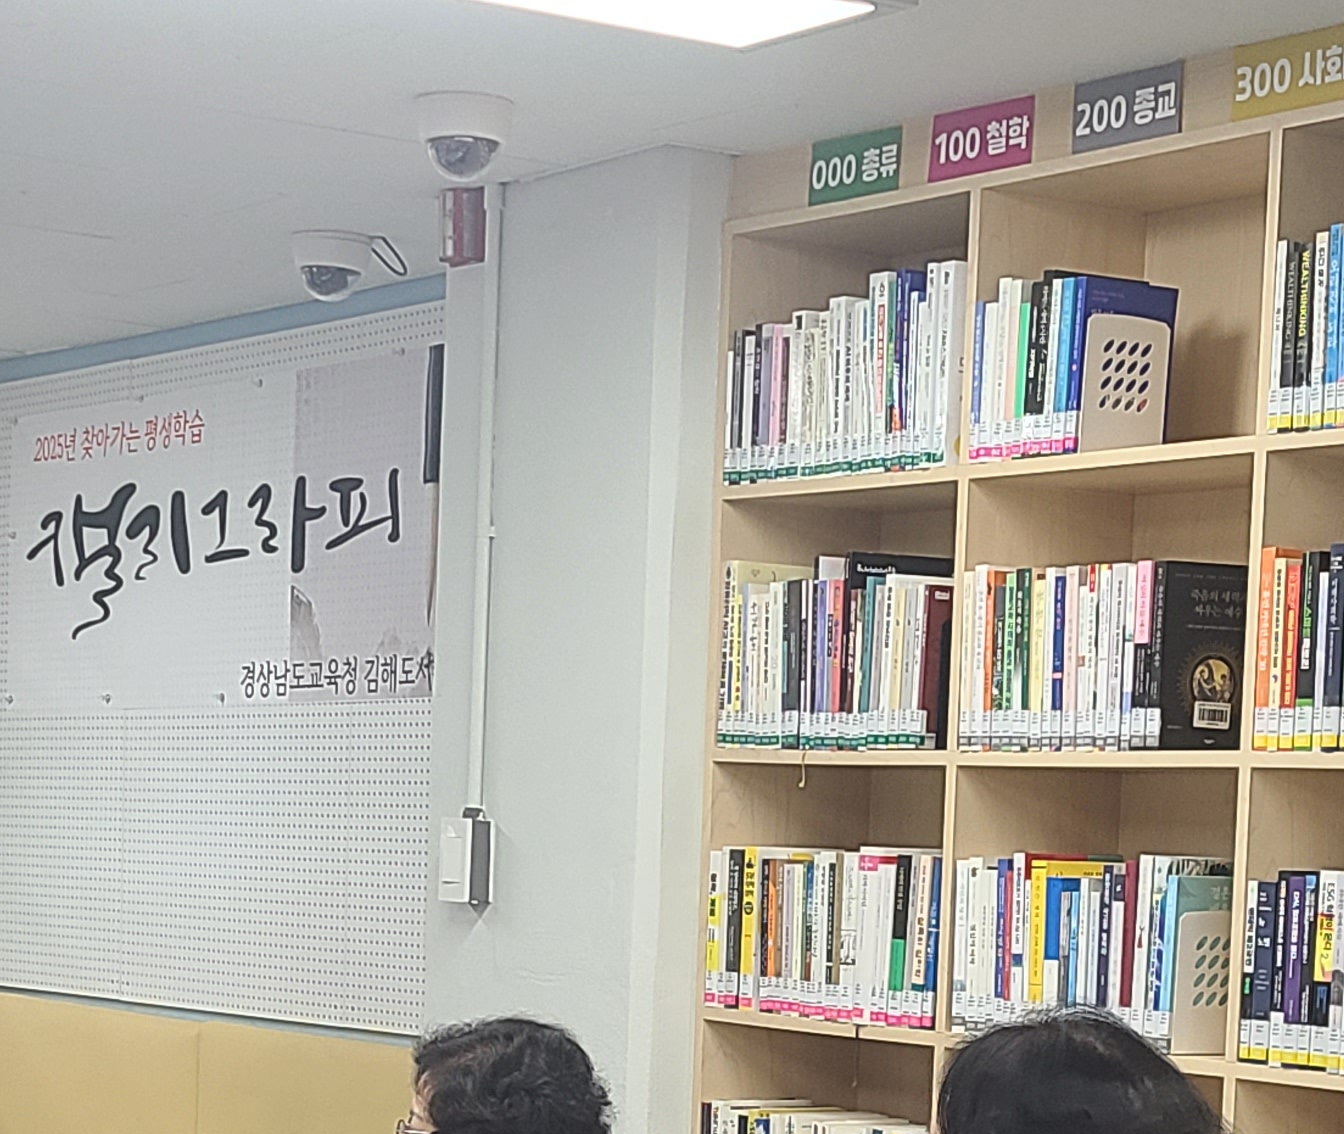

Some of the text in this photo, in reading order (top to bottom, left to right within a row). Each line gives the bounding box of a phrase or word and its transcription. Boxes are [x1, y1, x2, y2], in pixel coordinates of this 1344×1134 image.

[1235, 59, 1292, 104] 300
[1075, 83, 1177, 137] 200 종교
[935, 116, 1029, 165] 100 철학
[811, 143, 898, 190] 000 총류
[33, 409, 205, 463] 2025년 찾아가는 평생학습
[26, 467, 401, 640] 캘리그라피
[241, 655, 358, 698] 경상남도교육청
[1326, 883, 1336, 902] ESG
